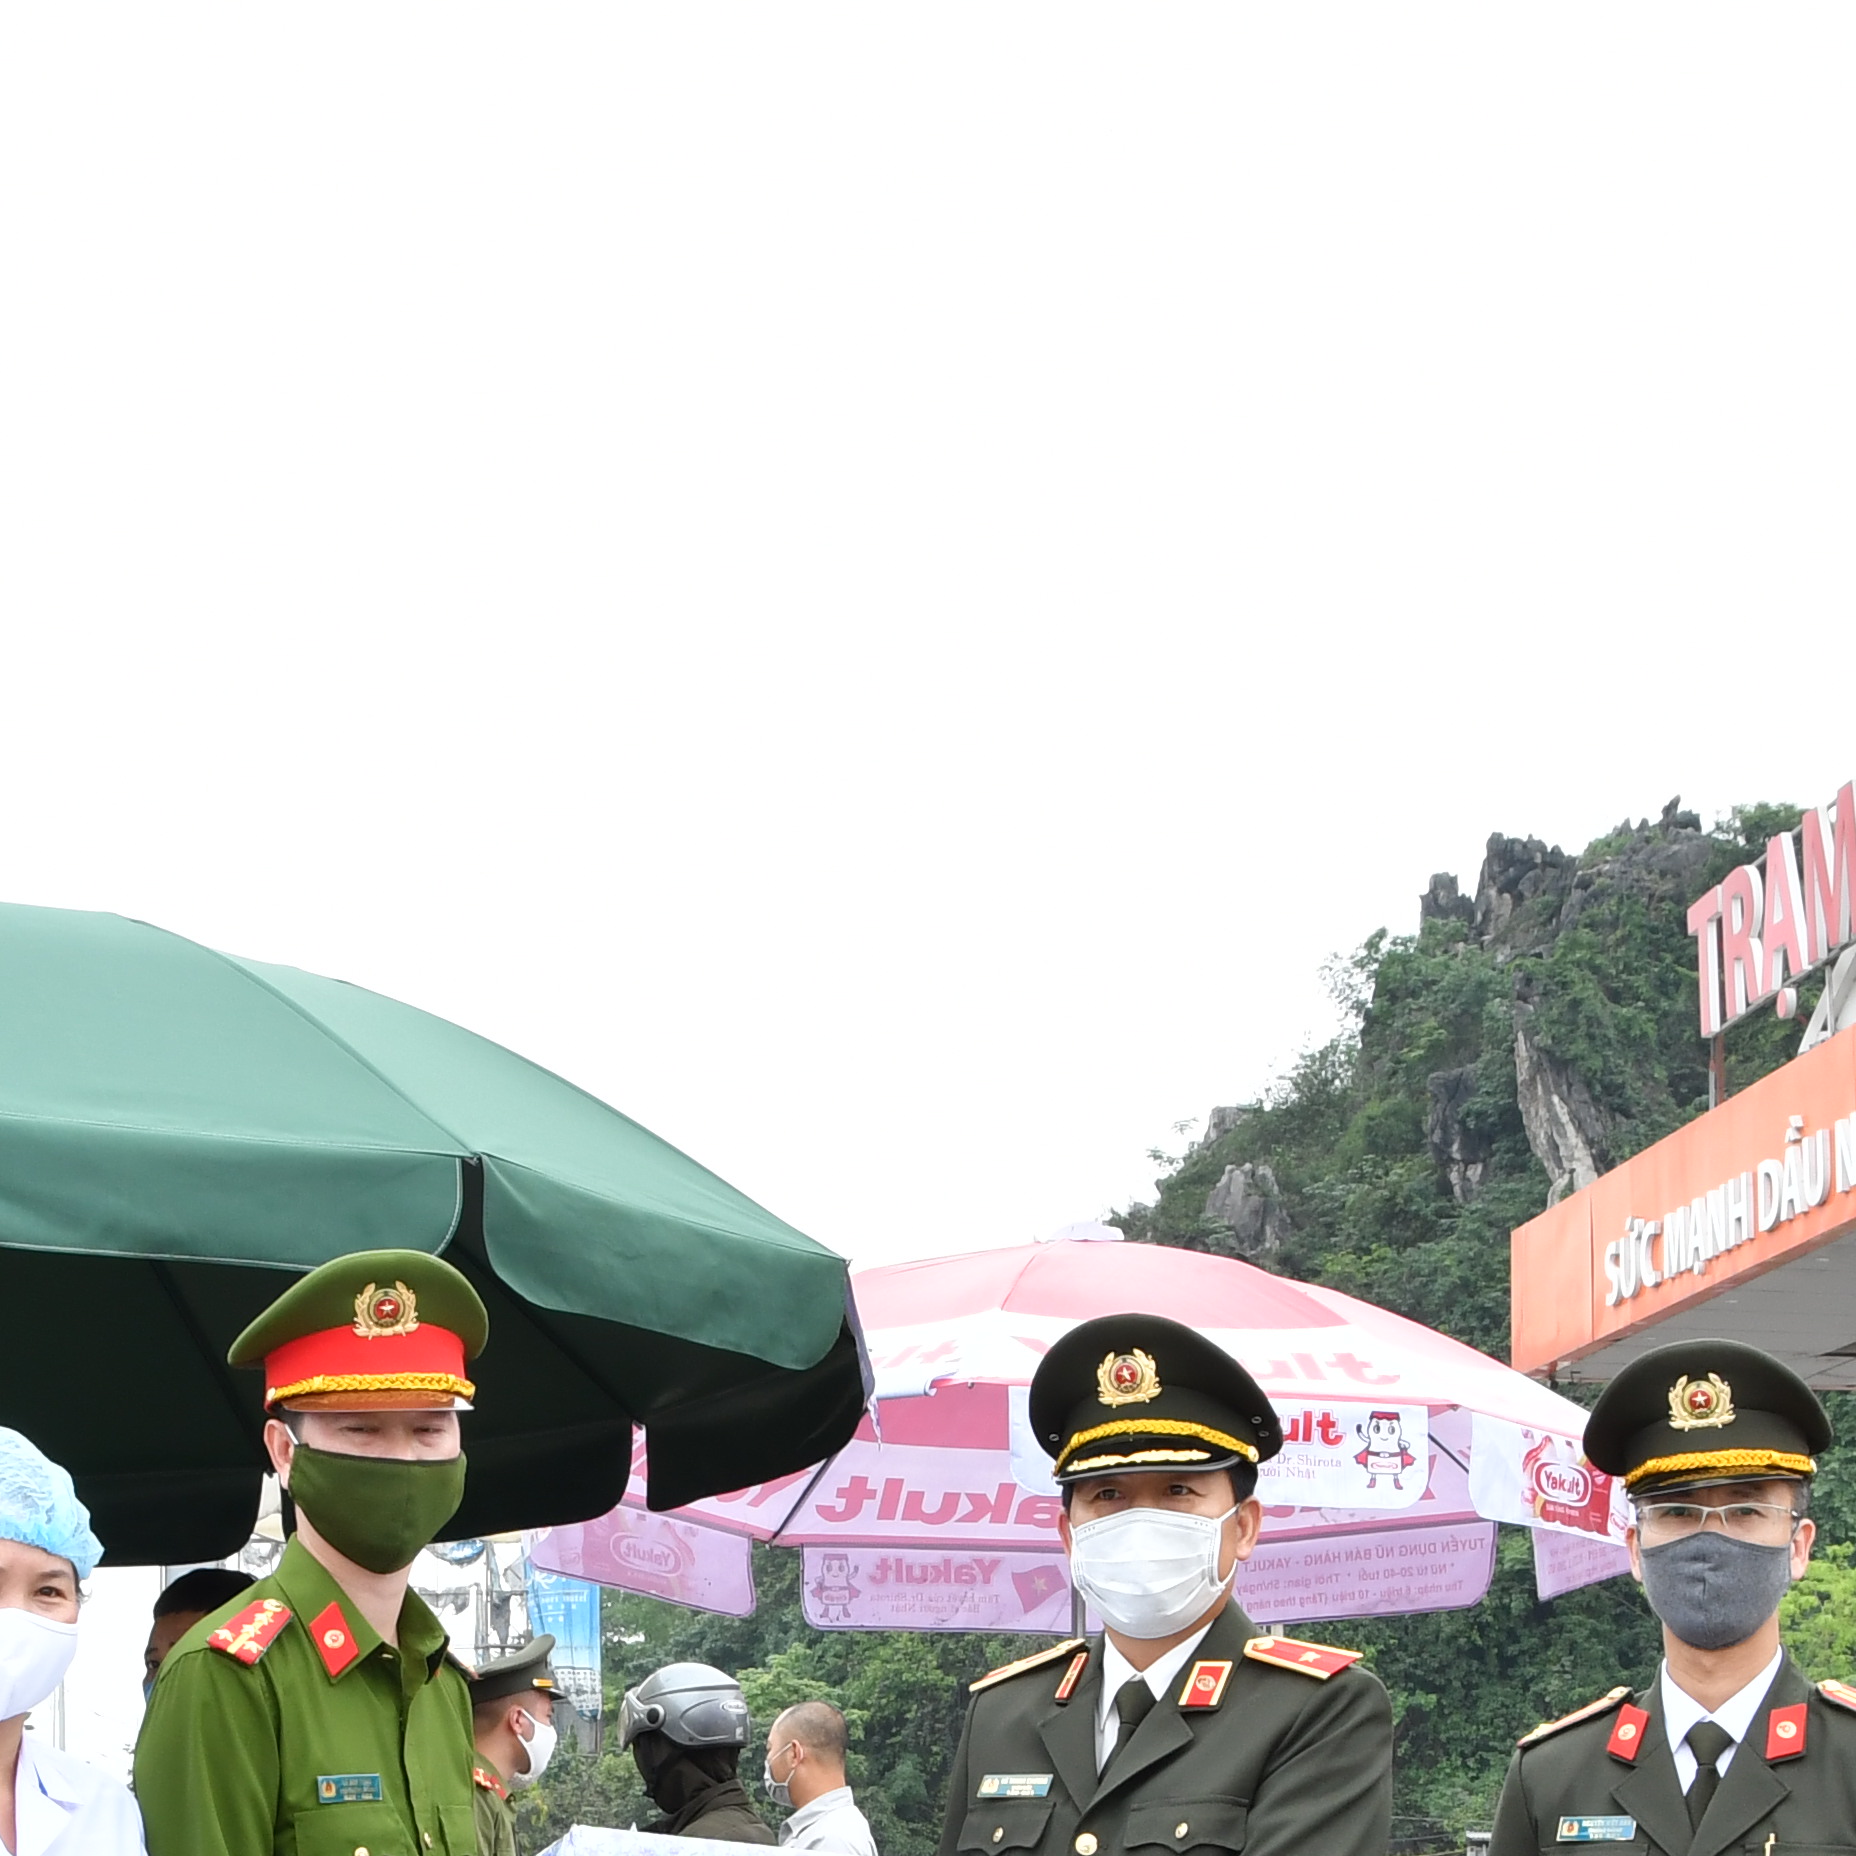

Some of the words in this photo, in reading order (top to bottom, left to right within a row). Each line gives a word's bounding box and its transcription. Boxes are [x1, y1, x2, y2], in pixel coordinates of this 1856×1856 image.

[1604, 1216, 1663, 1307] SỨC
[1663, 1172, 1755, 1279] MẠNH
[1757, 1114, 1831, 1232] DẦU
